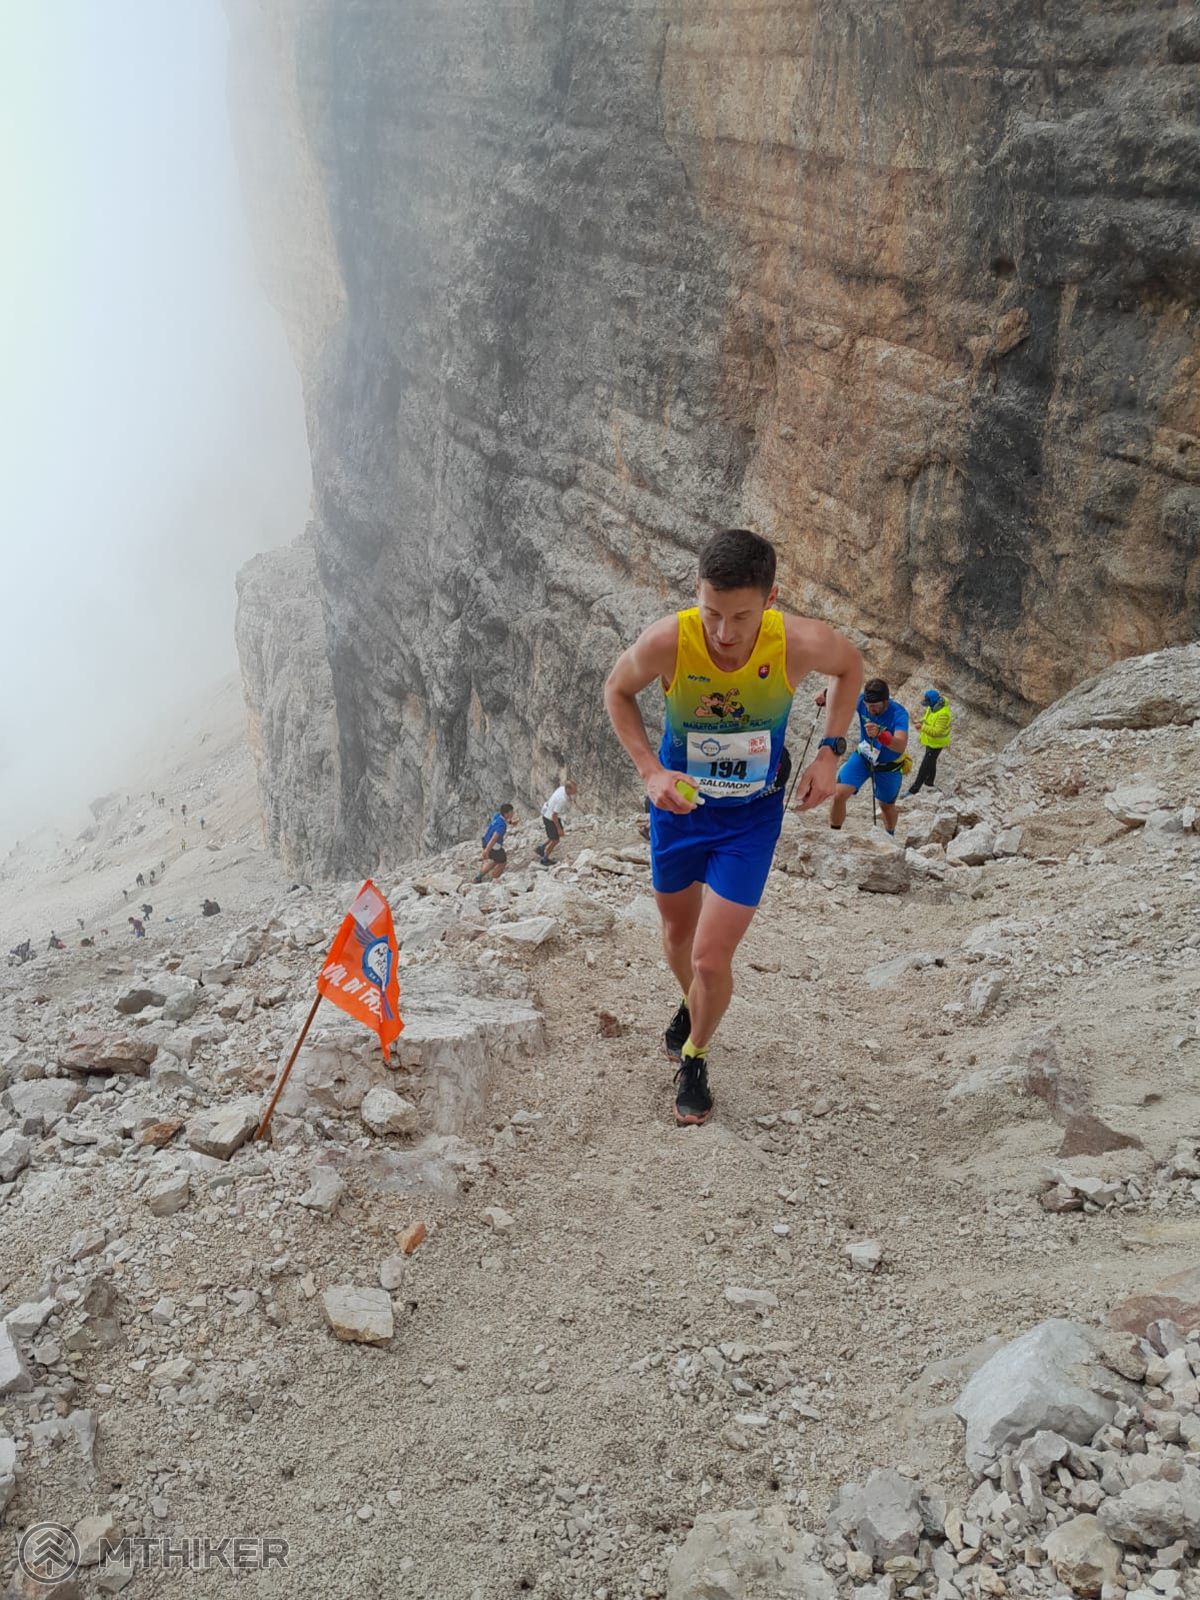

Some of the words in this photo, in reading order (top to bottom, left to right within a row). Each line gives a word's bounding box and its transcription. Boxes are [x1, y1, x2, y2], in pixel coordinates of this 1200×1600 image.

[710, 760, 747, 779] 194
[699, 778, 751, 790] SALOMON
[322, 962, 348, 988] VAL
